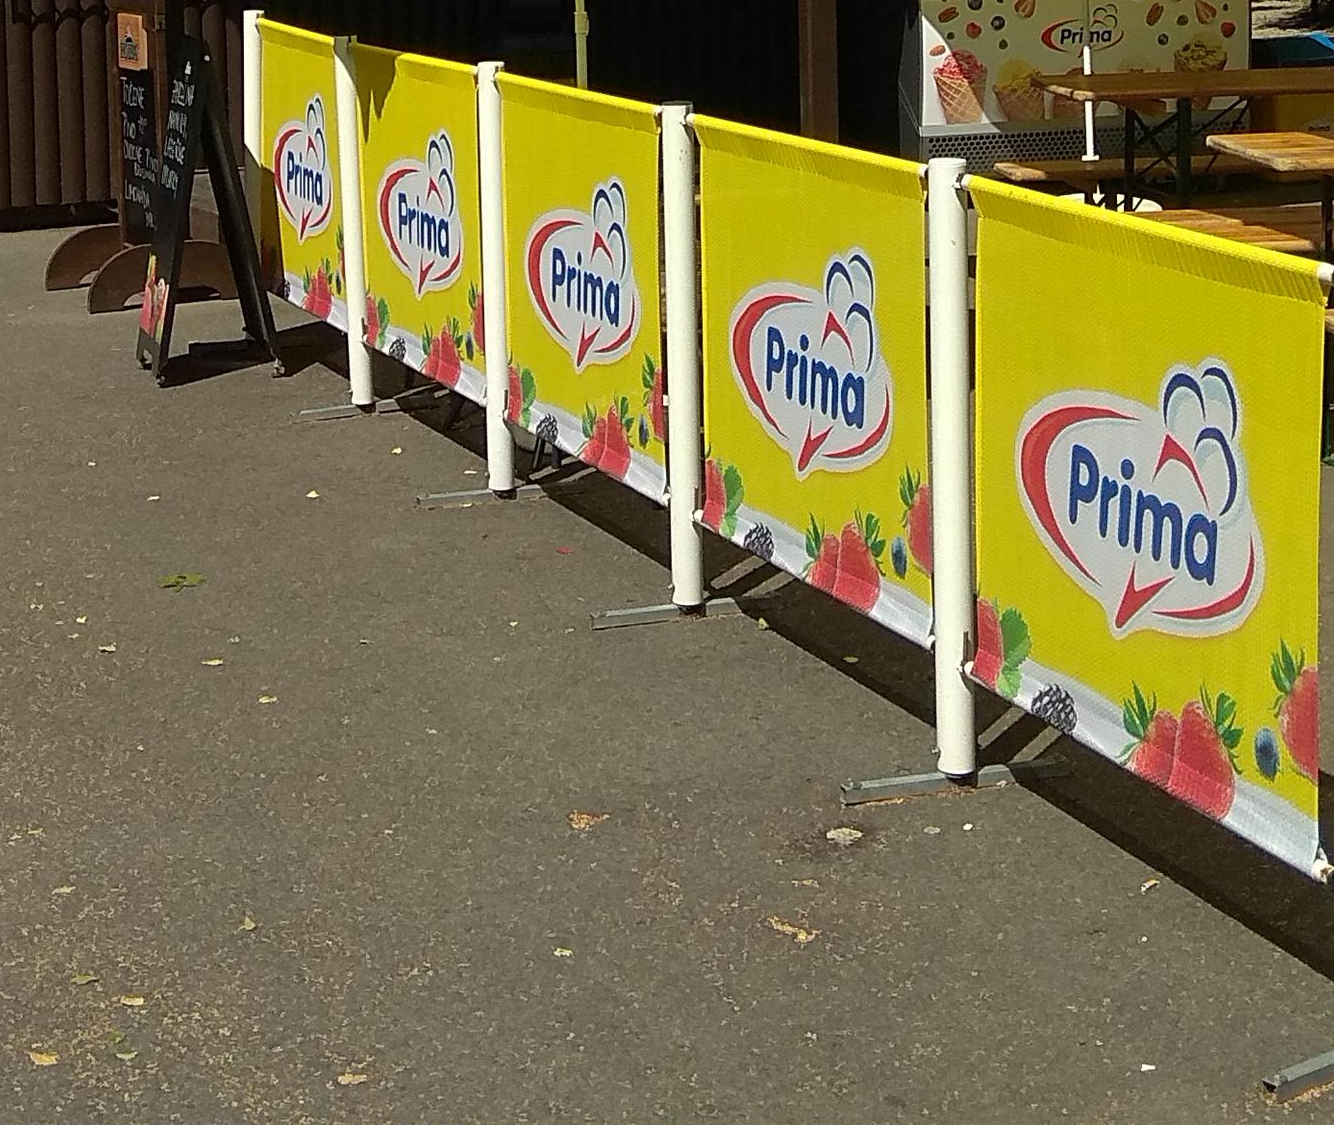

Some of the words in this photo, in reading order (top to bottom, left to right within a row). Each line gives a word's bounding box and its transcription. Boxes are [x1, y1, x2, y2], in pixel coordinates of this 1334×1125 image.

[285, 149, 325, 208] Prima
[396, 190, 451, 260] Prima
[550, 244, 621, 328] Prima
[764, 325, 866, 430] Prima
[1067, 442, 1218, 586] Prima
